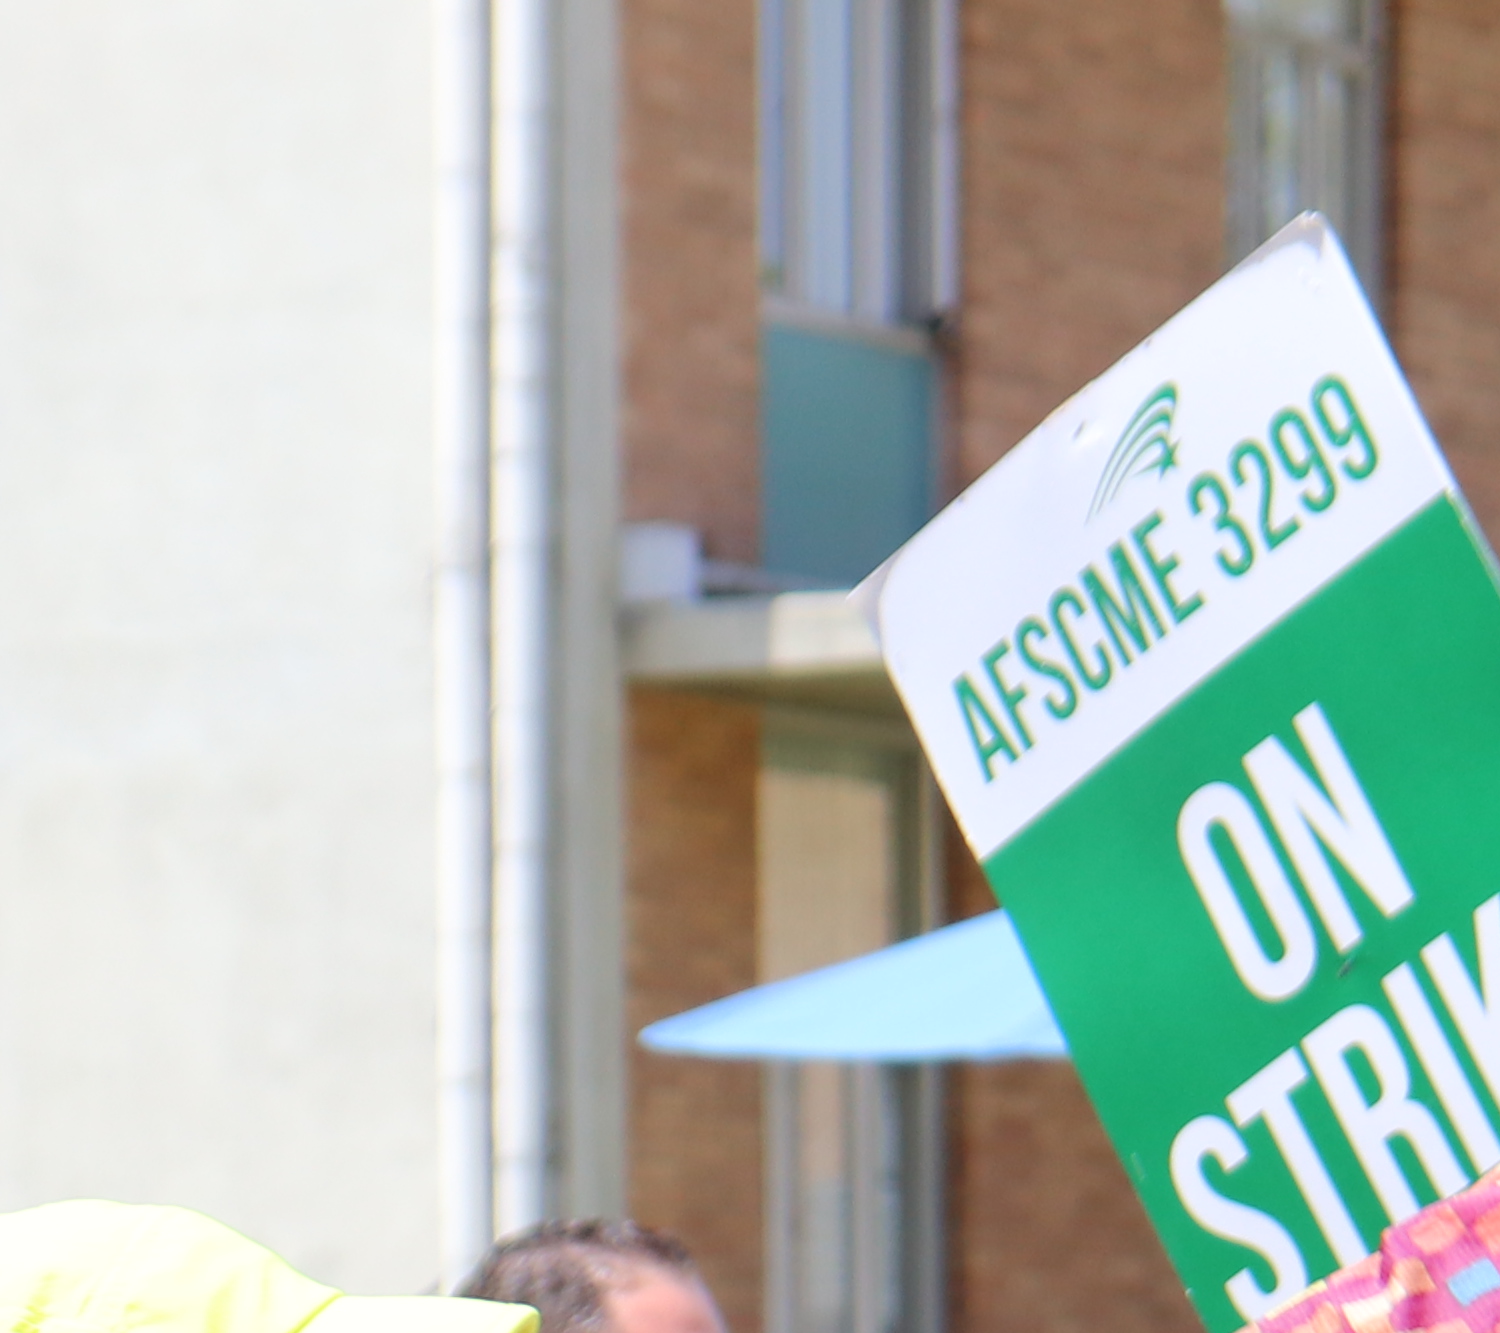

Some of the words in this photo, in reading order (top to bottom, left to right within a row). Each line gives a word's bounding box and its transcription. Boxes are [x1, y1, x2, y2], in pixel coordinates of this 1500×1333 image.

[953, 512, 1206, 782] AFSCME
[1189, 373, 1379, 578] 3299
[1177, 702, 1415, 1002] ON
